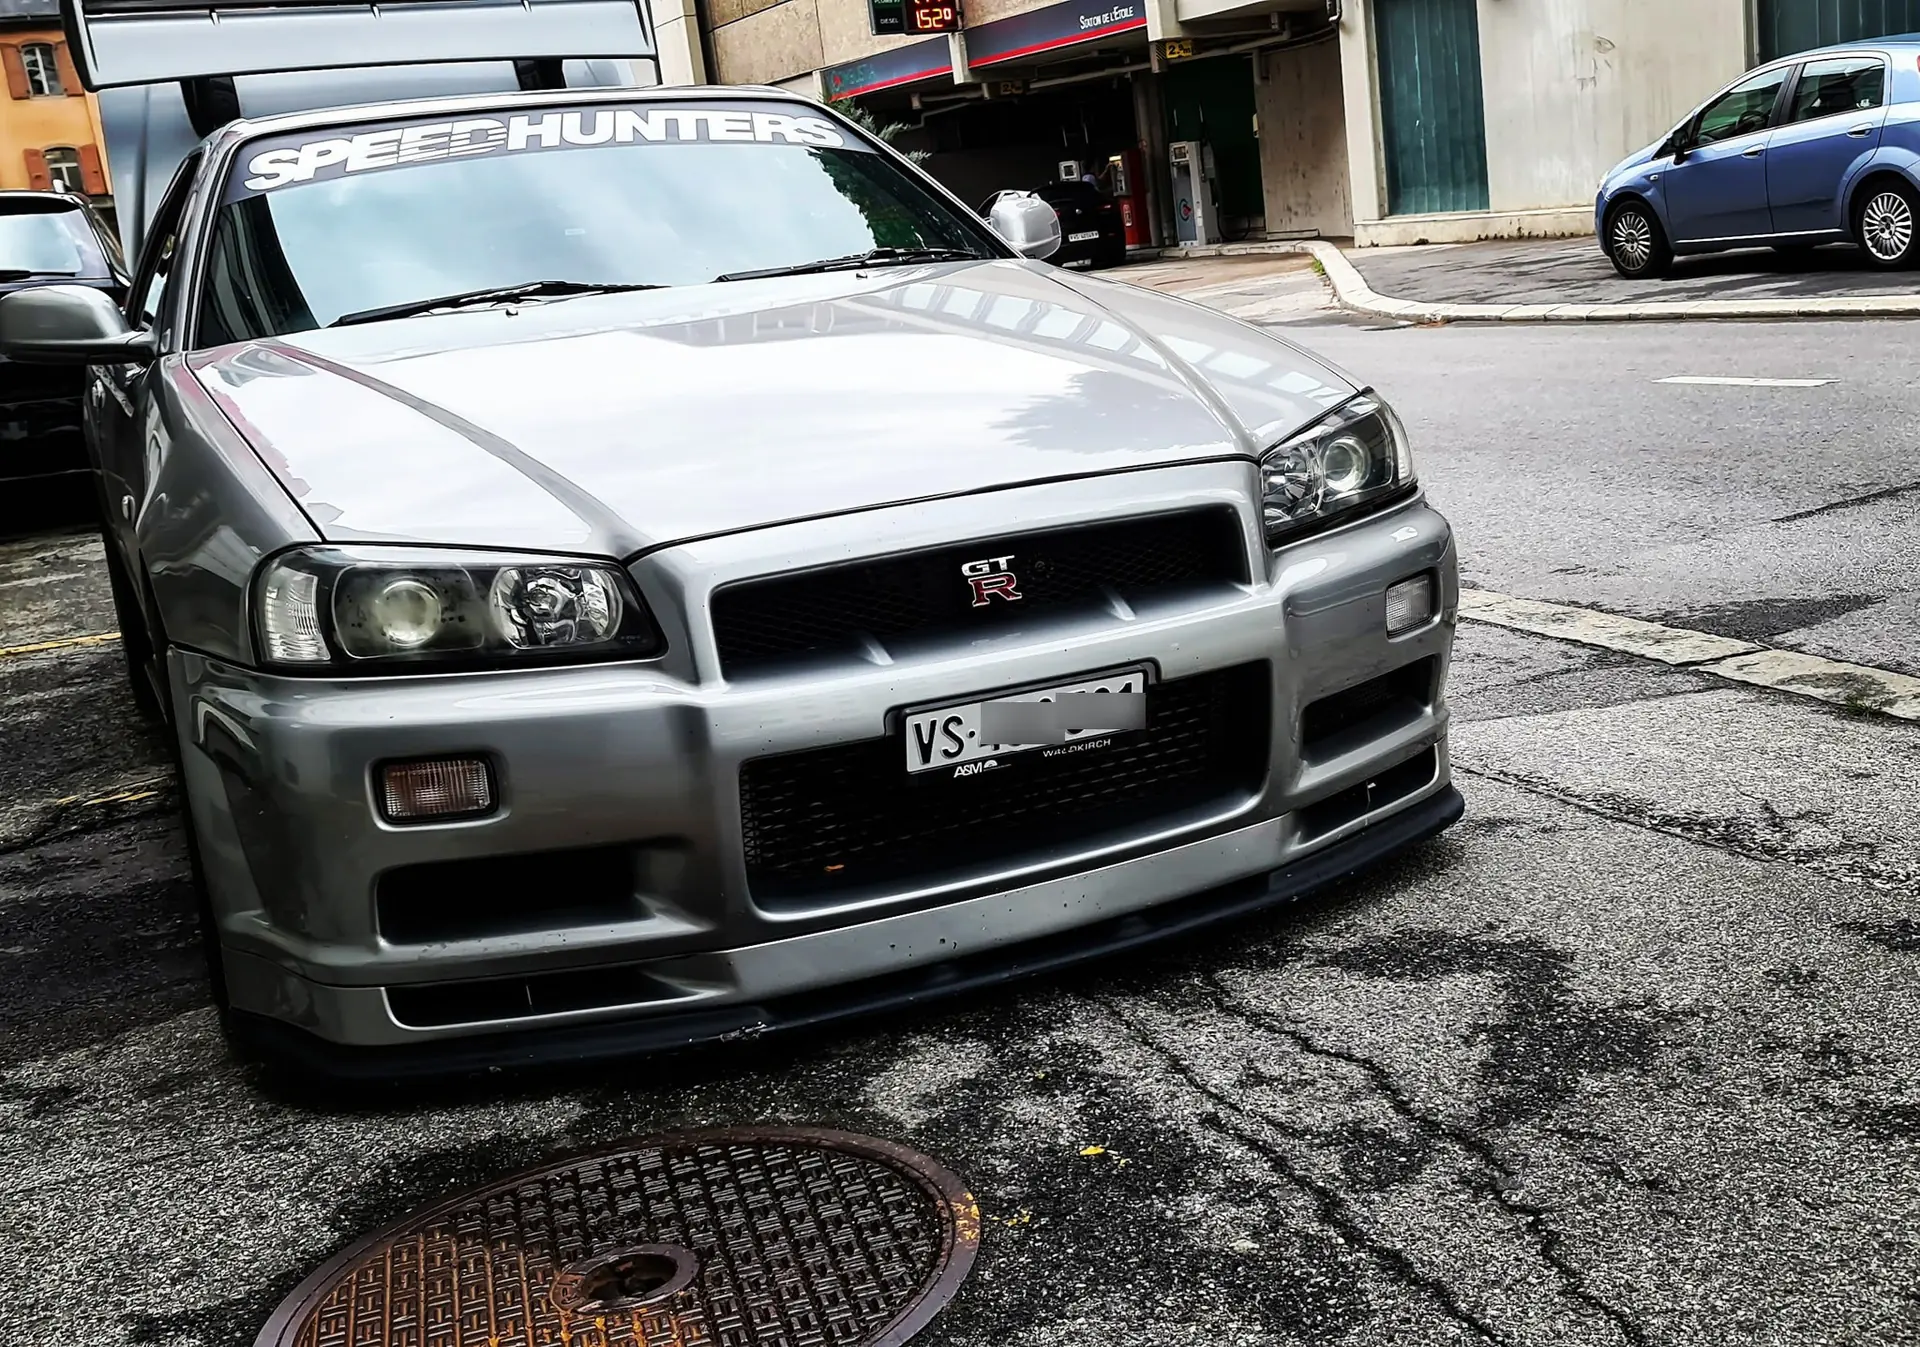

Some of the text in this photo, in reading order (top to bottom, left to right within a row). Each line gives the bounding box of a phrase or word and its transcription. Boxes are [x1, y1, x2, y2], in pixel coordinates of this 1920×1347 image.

[243, 108, 845, 191] SPEEDHUNTERS
[961, 555, 1015, 576] GT
[968, 572, 1022, 607] R
